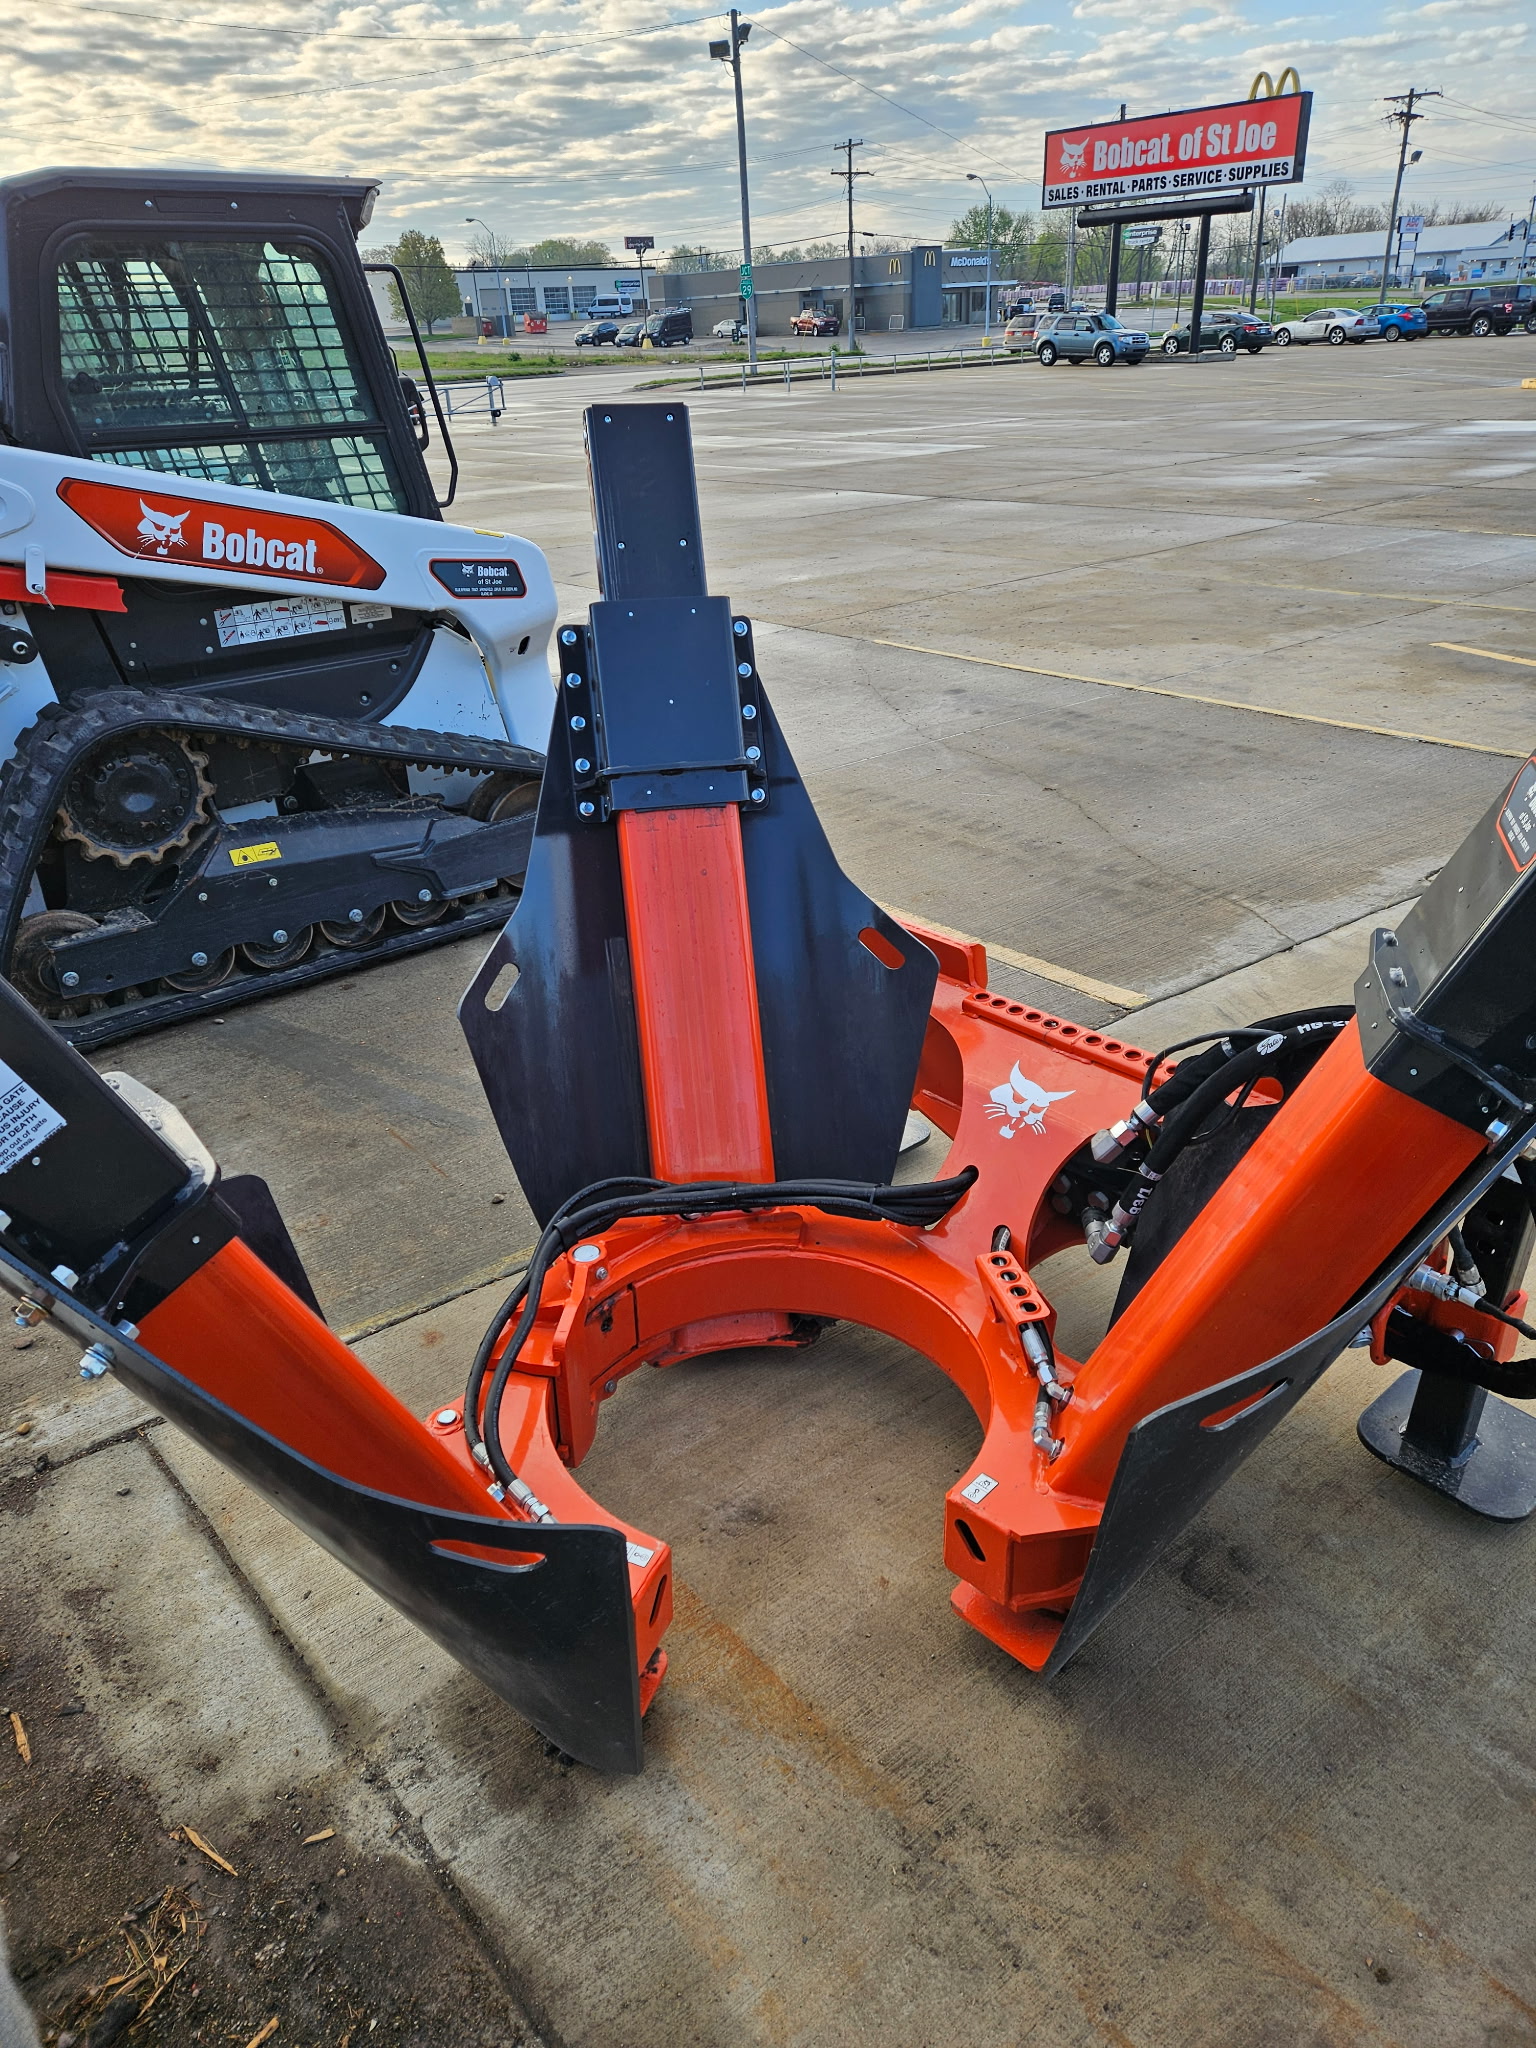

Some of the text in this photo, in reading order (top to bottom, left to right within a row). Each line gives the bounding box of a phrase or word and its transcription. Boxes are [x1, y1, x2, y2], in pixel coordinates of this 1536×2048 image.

[1093, 119, 1277, 172] Bobcat of St Joe
[1048, 161, 1289, 202] SALES RENTAL PARTS SERVICE SUPPLIES
[741, 265, 751, 276] JCT
[742, 285, 752, 295] 29
[202, 521, 317, 574] Bobcat
[477, 565, 508, 577] Bobcat
[3, 1085, 27, 1105] GATE
[10, 1097, 41, 1124] INJURY
[8, 1113, 38, 1138] DEATH
[9, 1137, 22, 1149] out
[22, 1130, 31, 1138] of
[31, 1117, 48, 1133] gate
